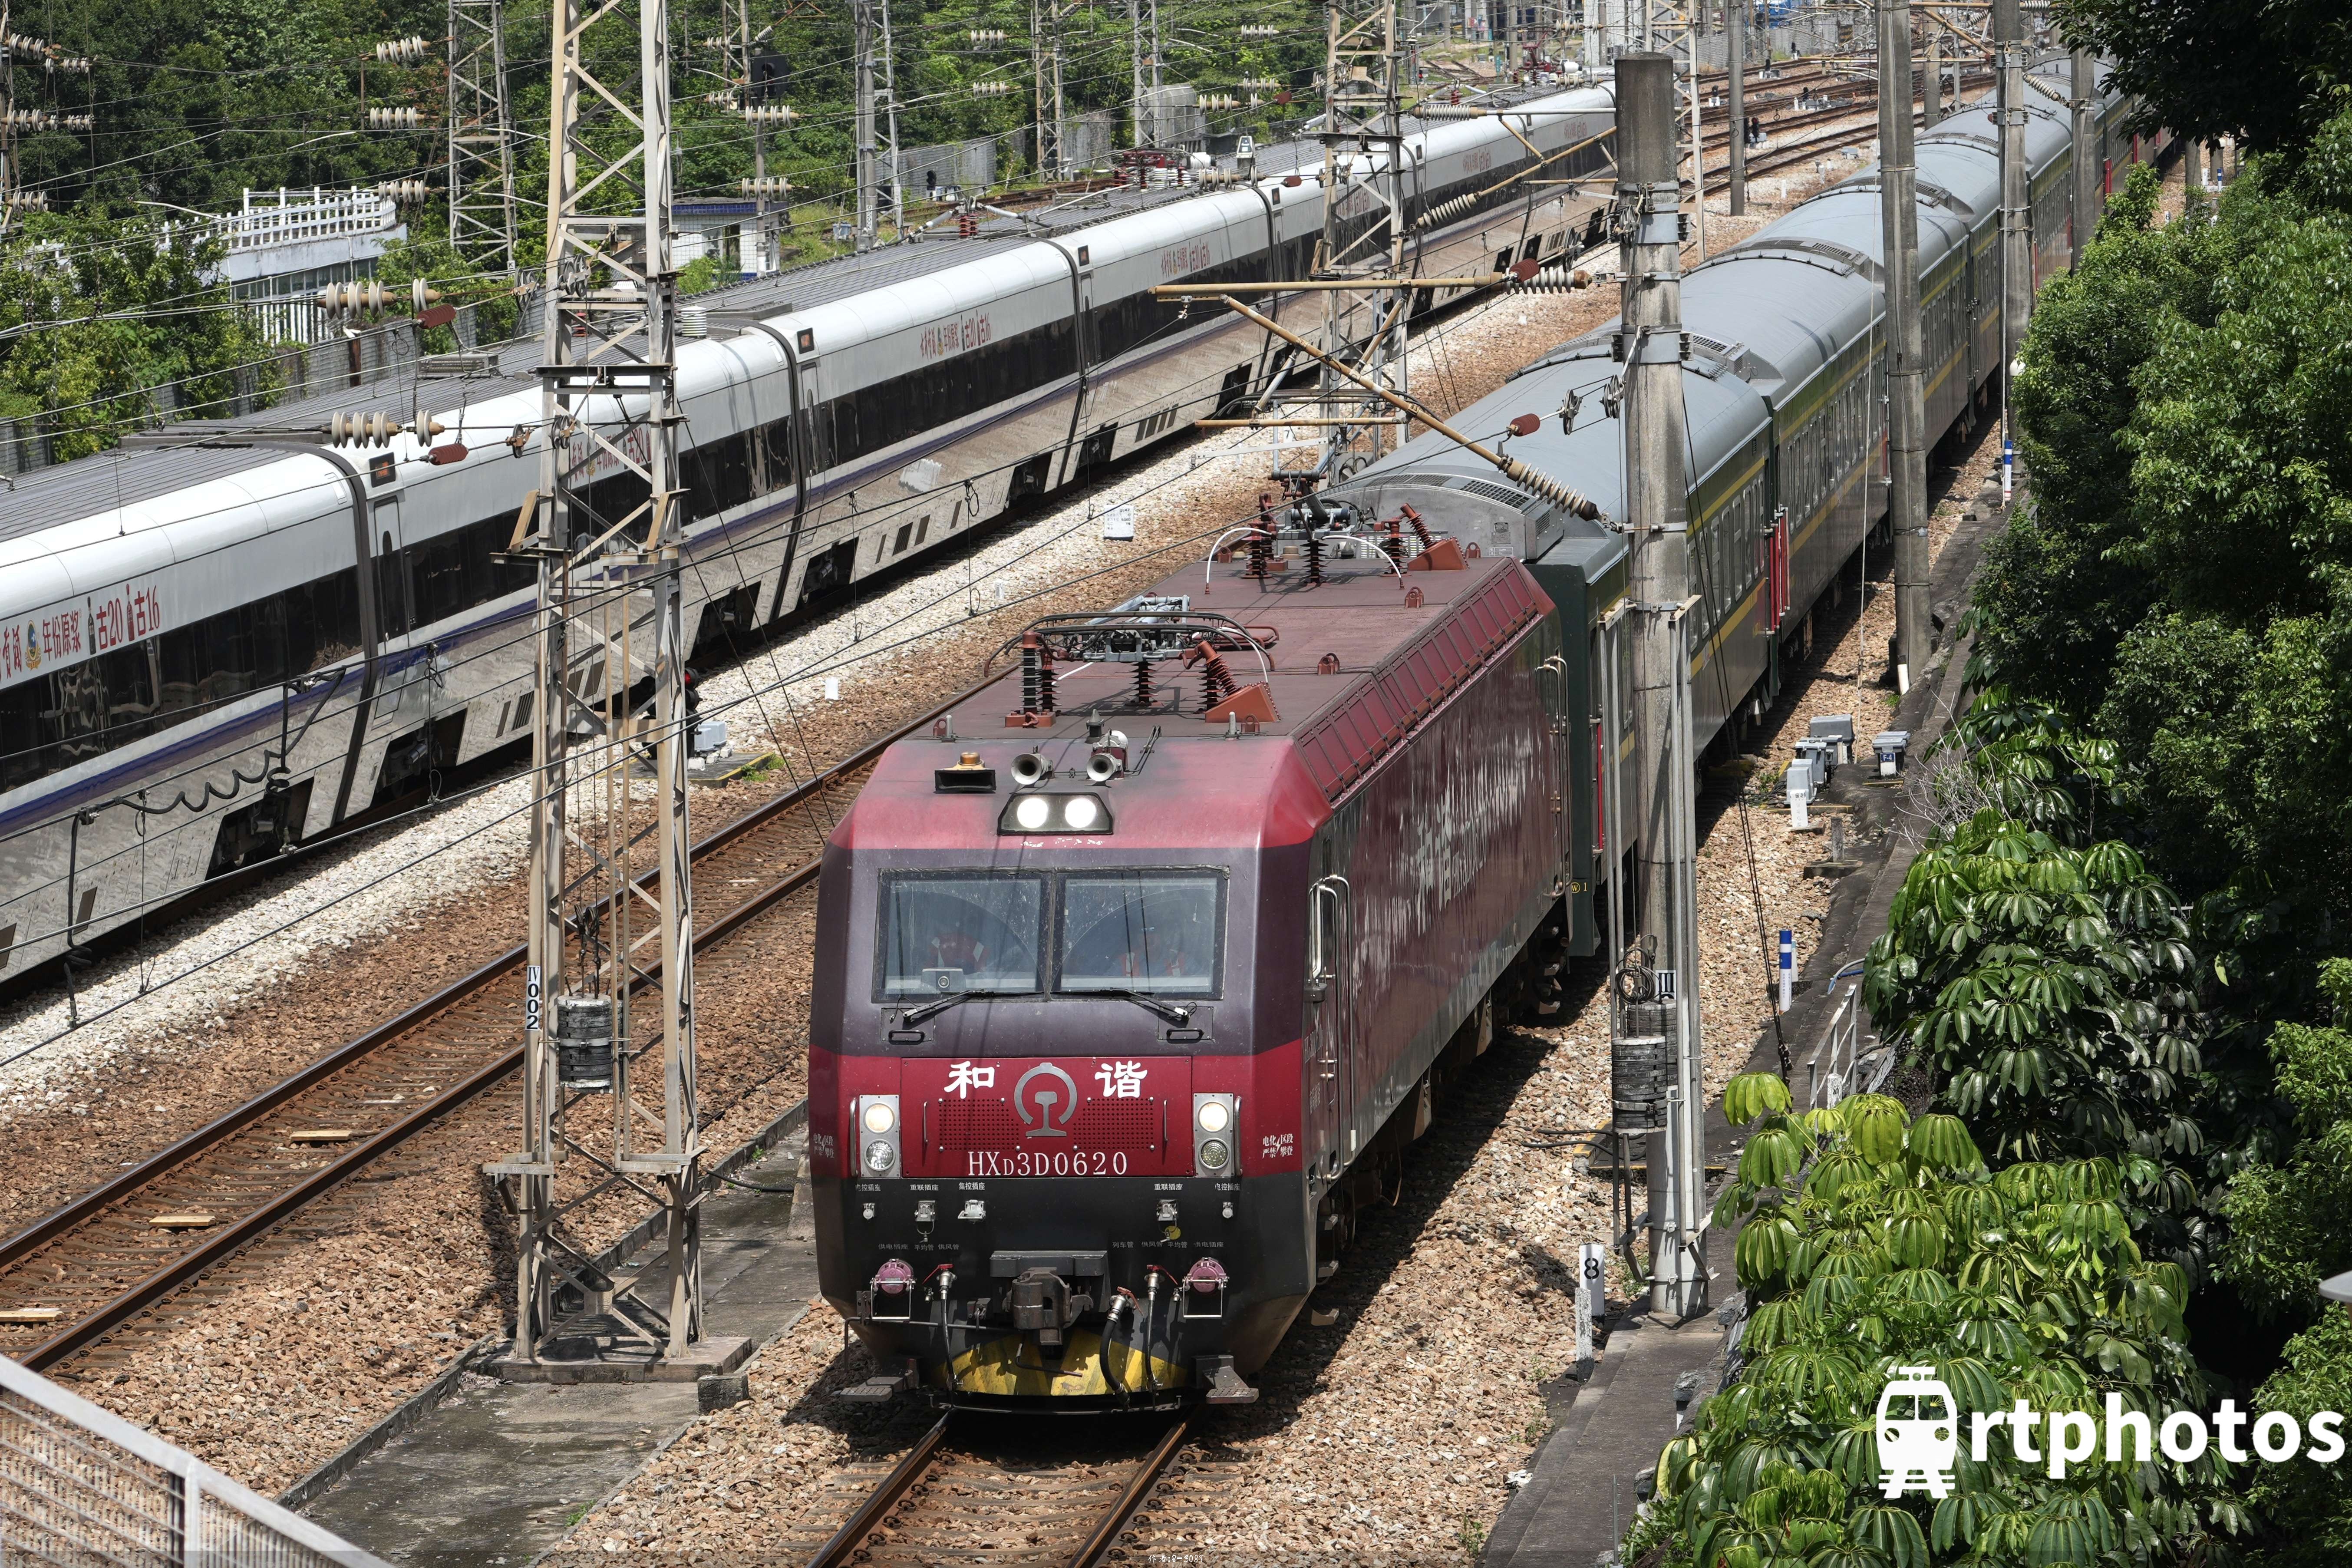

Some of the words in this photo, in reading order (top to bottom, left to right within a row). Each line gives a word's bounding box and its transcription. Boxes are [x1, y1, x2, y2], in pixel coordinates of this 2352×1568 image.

[965, 317, 976, 349] 古20
[980, 312, 991, 343] 古16
[1284, 430, 1290, 439] 7
[43, 610, 81, 661] 年份原浆
[96, 597, 123, 650] 古20
[134, 585, 160, 636] 古16
[967, 1151, 1128, 1176] HXD3D0620
[958, 1182, 985, 1191] 集控插座
[1215, 1183, 1240, 1191] 电控插座
[1584, 1258, 1599, 1280] 8
